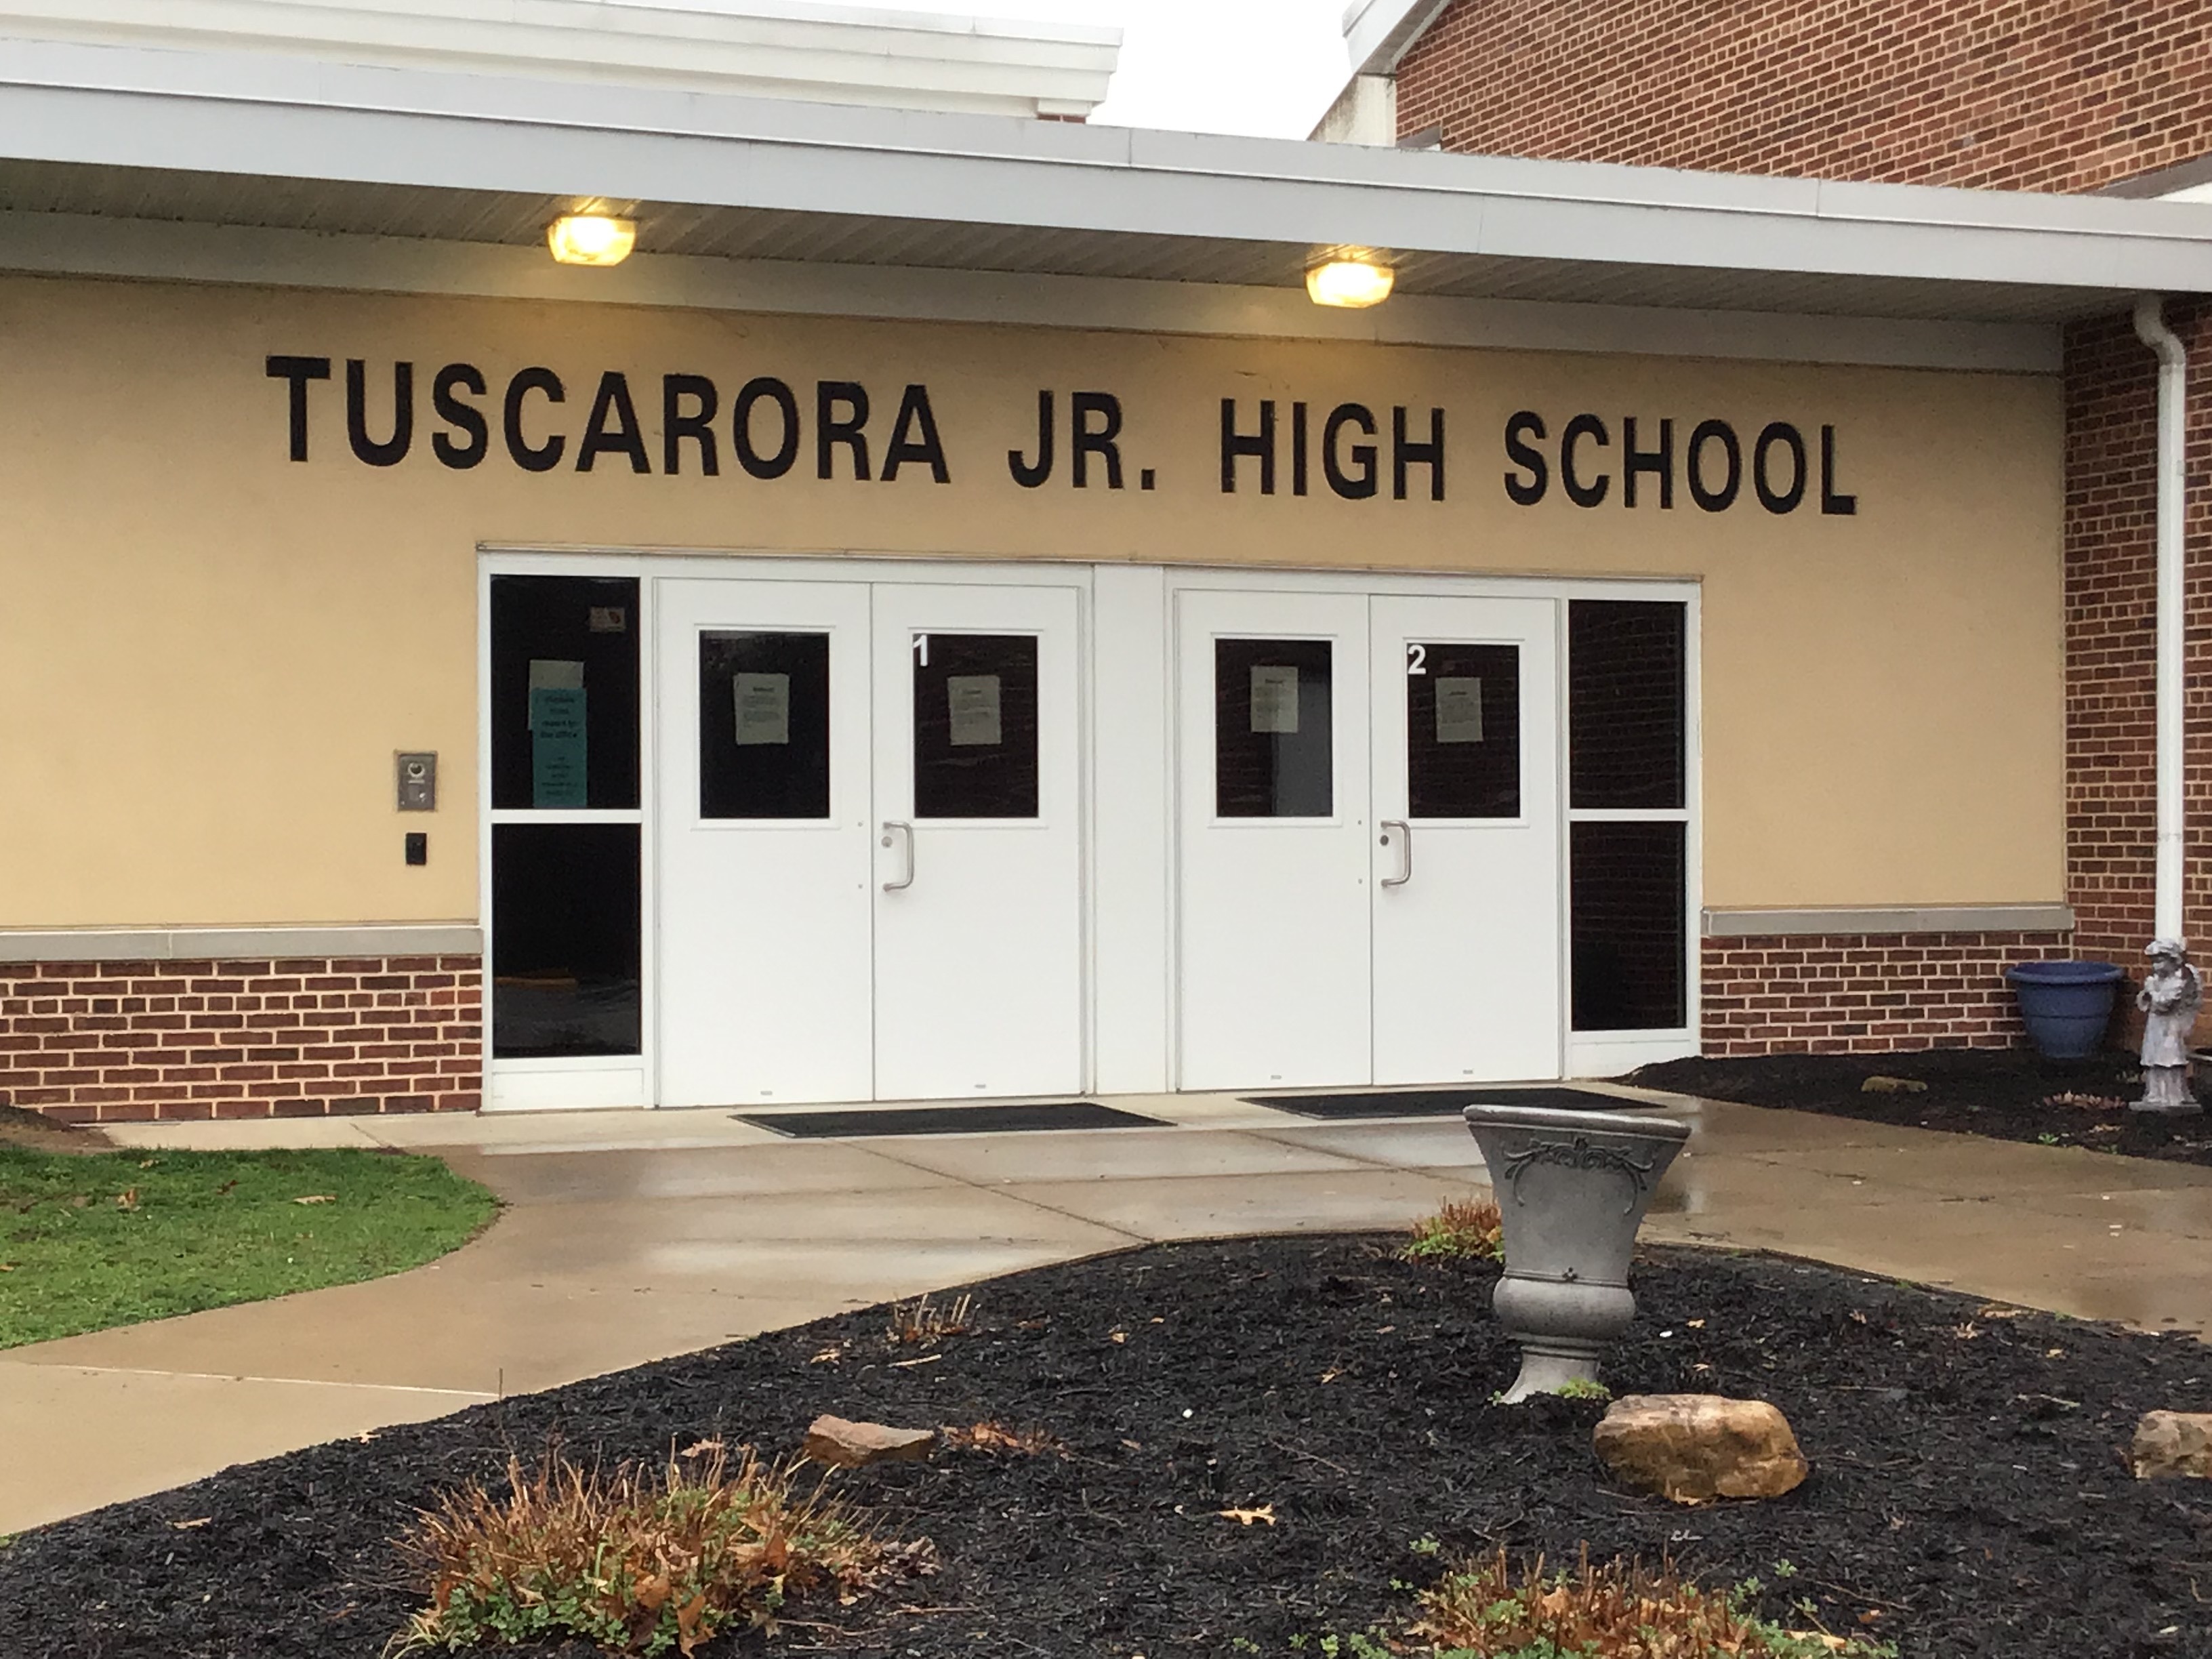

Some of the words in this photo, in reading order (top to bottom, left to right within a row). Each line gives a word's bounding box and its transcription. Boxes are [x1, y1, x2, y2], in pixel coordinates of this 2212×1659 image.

[265, 354, 951, 484] TUSCARORA
[1007, 389, 1156, 491] JR.
[1220, 398, 1446, 502] HIGH
[1504, 410, 1858, 516] SCHOOL
[913, 634, 928, 665] 1
[1408, 644, 1427, 674] 2
